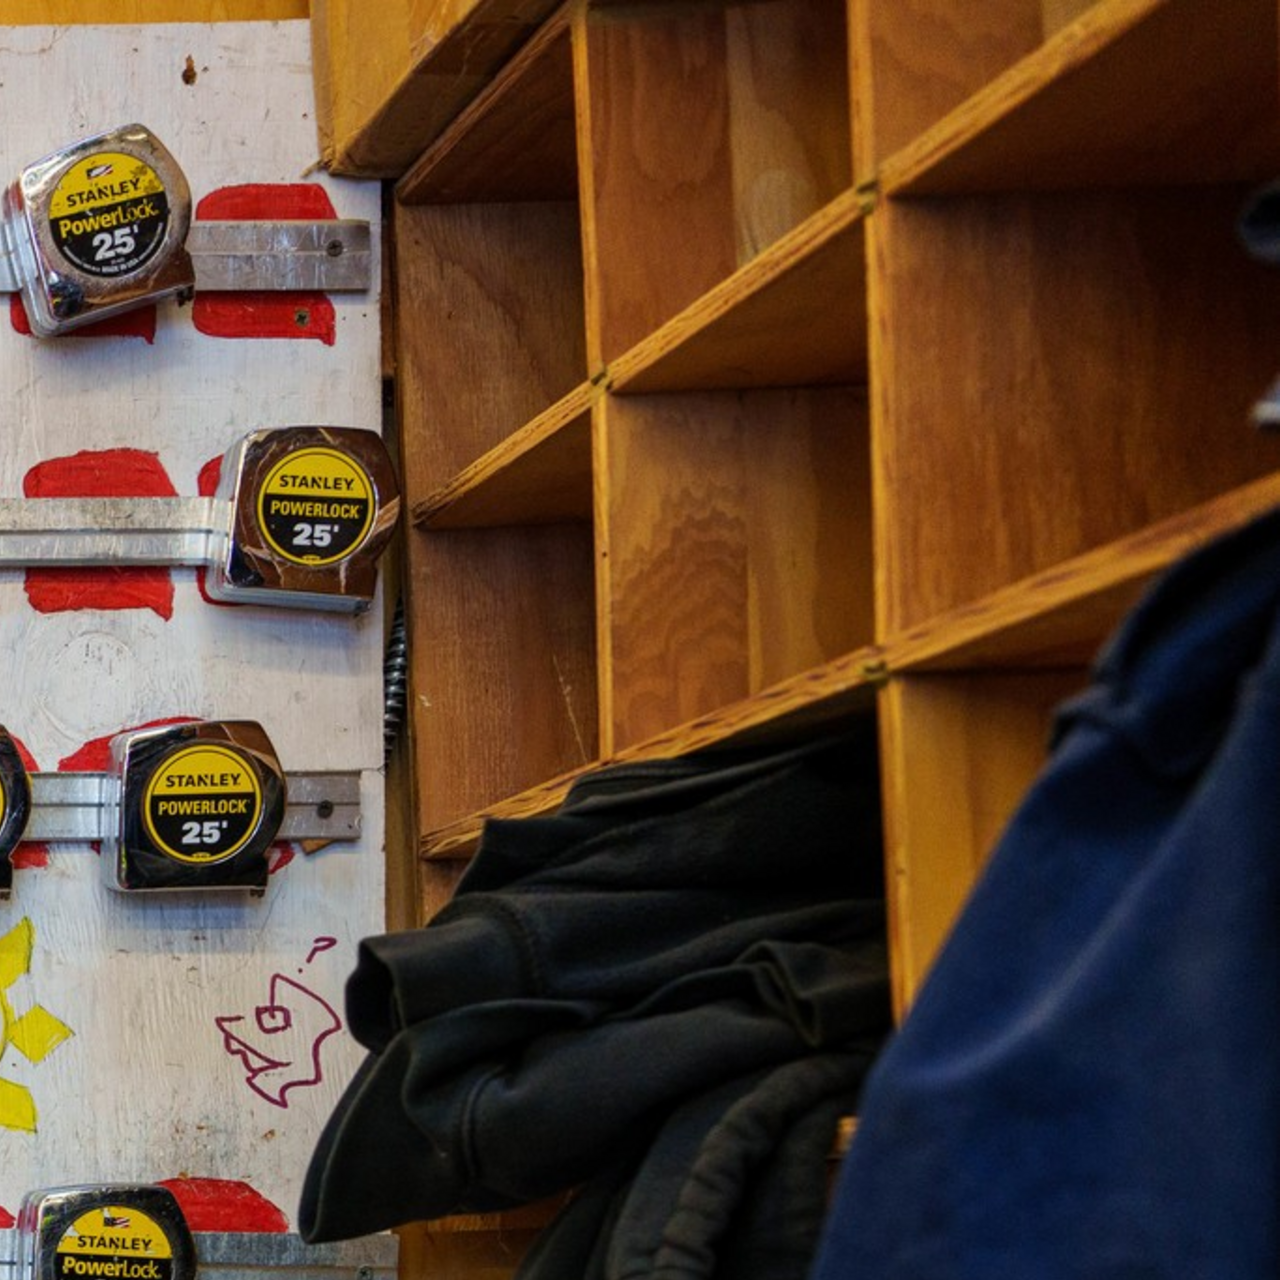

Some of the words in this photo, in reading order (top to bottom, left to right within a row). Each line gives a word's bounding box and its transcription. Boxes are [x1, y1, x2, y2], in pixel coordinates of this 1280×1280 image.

[65, 178, 140, 208] STANLEY
[58, 198, 156, 239] PowerLock
[92, 225, 139, 261] 25'
[279, 475, 355, 491] STANLEY
[270, 501, 360, 519] POWERLOCK
[292, 522, 339, 547] 25'
[165, 773, 242, 787] STANLEY
[158, 800, 247, 815] POWERLOCK
[181, 820, 228, 845] 25'
[77, 1235, 152, 1250] STANLEY
[63, 1256, 159, 1279] PowerLock
